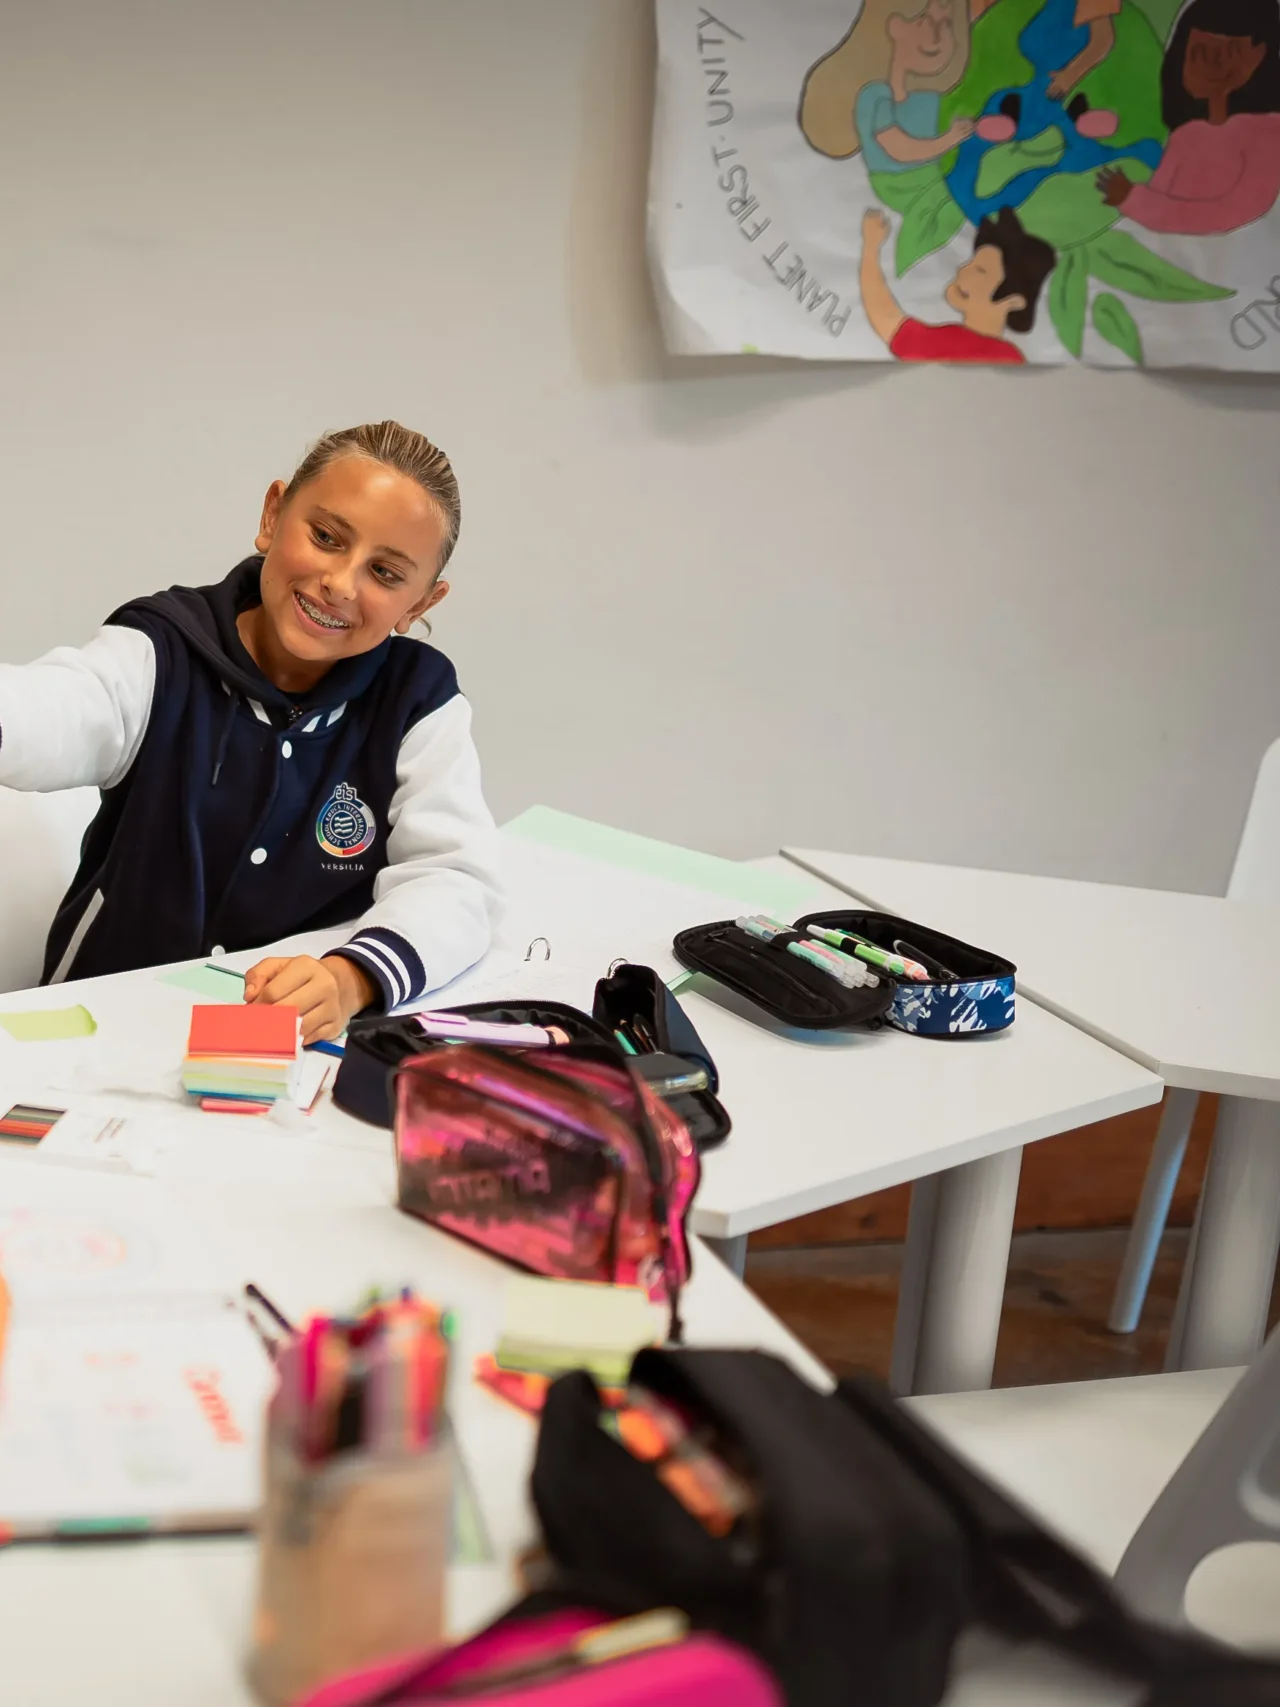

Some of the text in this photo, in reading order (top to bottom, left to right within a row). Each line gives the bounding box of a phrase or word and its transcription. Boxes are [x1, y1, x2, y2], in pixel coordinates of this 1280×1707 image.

[696, 6, 852, 335] PLANET FIRST UNITY
[321, 862, 365, 872] VERSILIA
